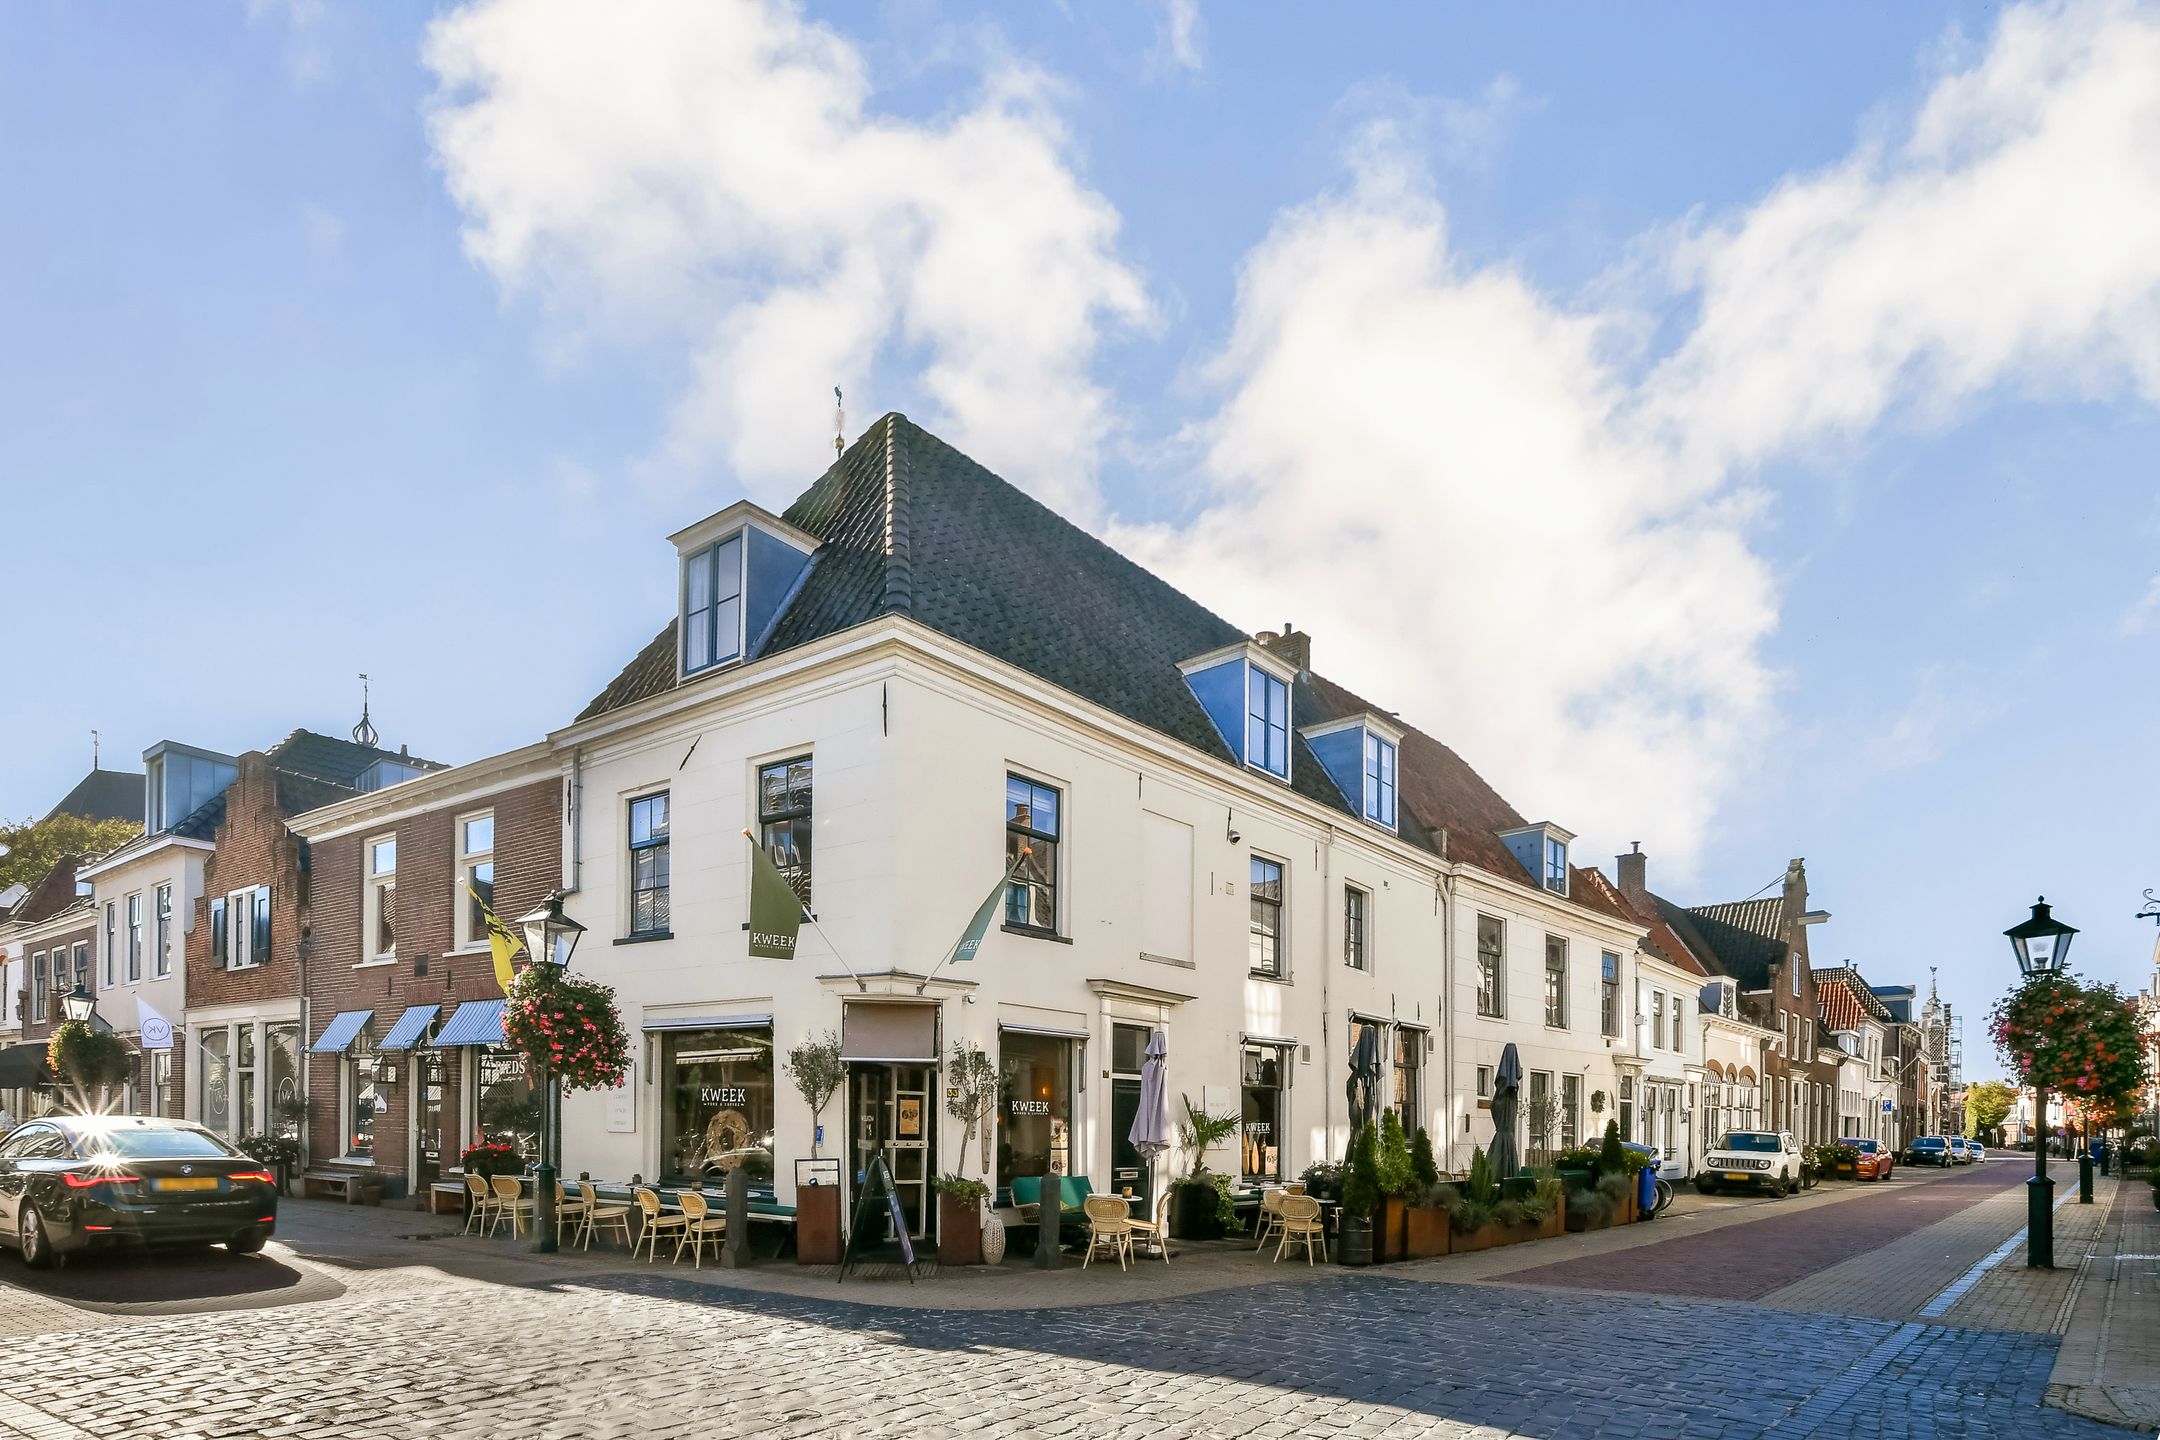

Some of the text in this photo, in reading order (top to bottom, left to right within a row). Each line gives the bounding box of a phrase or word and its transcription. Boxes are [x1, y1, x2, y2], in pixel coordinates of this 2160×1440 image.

[753, 932, 796, 947] KWEEK
[701, 1088, 746, 1102] KWEEK
[1012, 1100, 1049, 1112] KWEEK
[1246, 1123, 1271, 1132] KWEEK
